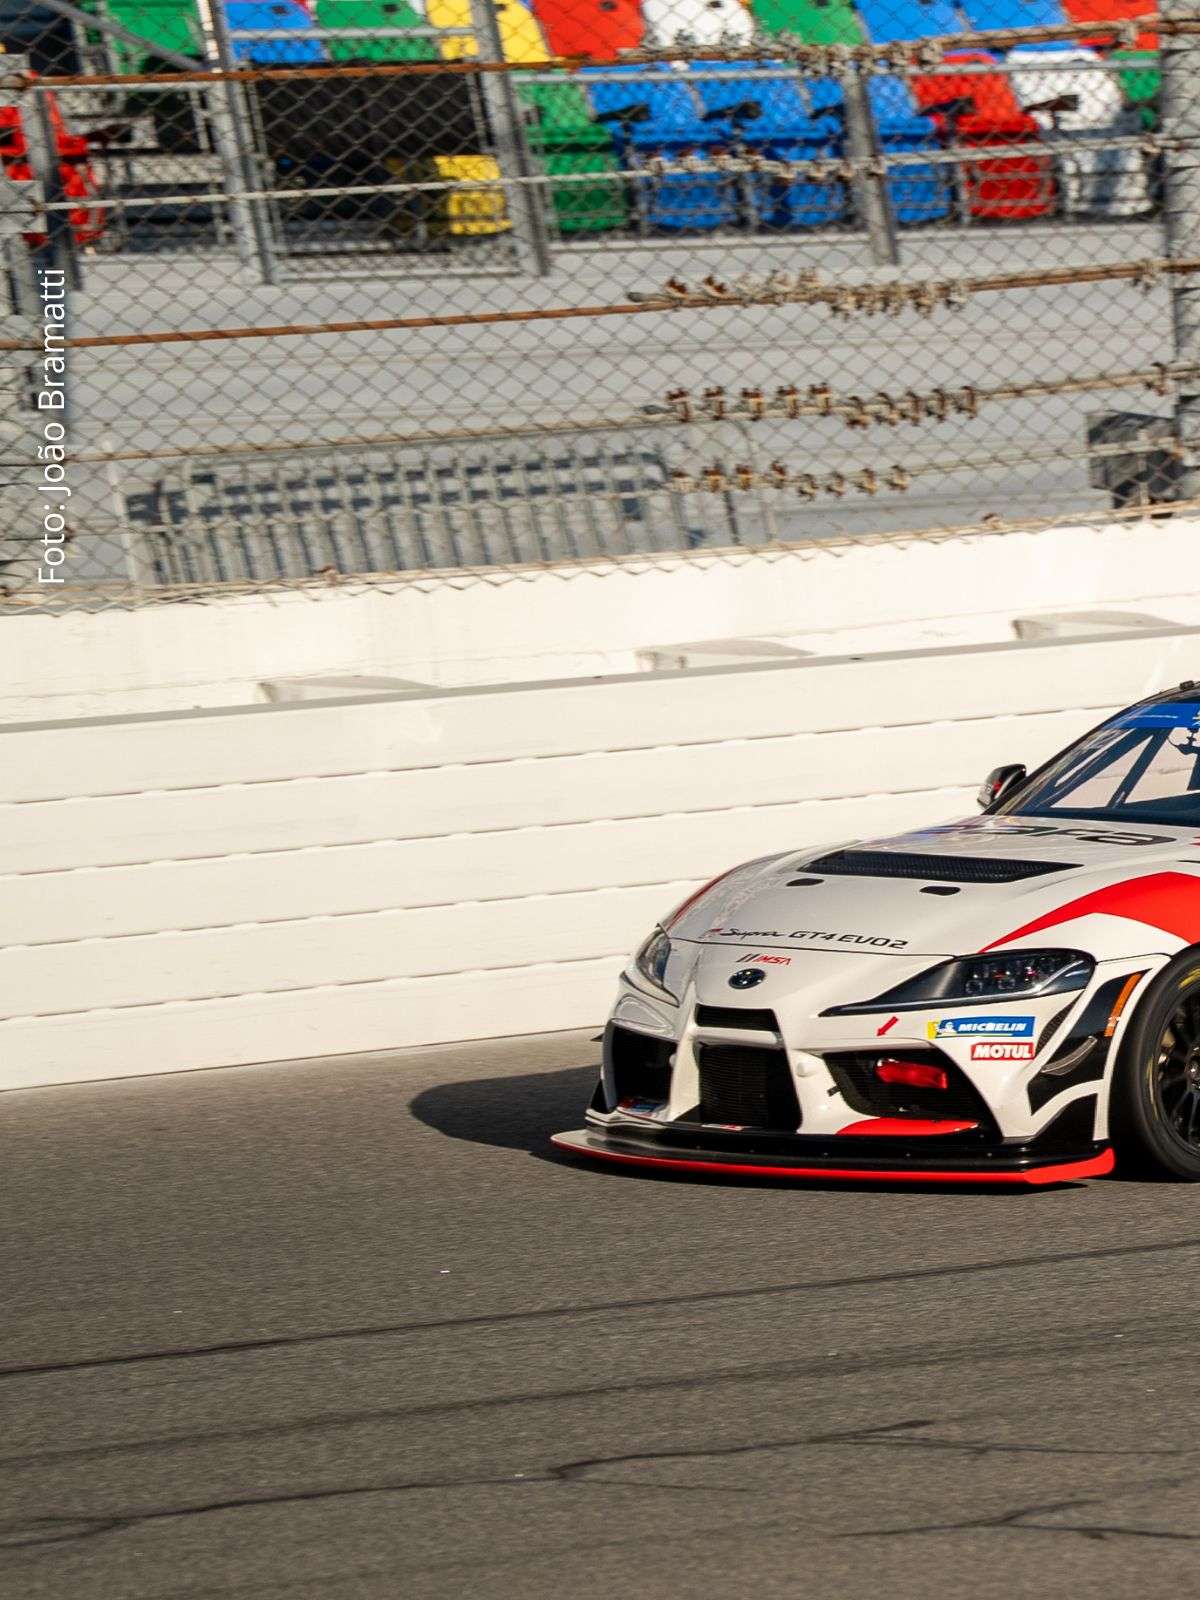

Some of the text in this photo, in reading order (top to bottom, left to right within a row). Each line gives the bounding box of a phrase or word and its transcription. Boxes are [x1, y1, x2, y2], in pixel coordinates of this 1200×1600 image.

[720, 927, 786, 940] Supra
[788, 930, 838, 941] GT4
[838, 934, 909, 950] EVO2
[752, 953, 792, 966] IMSA
[957, 1022, 1027, 1032] MICHELIN
[972, 1044, 1033, 1059] MOTUL
